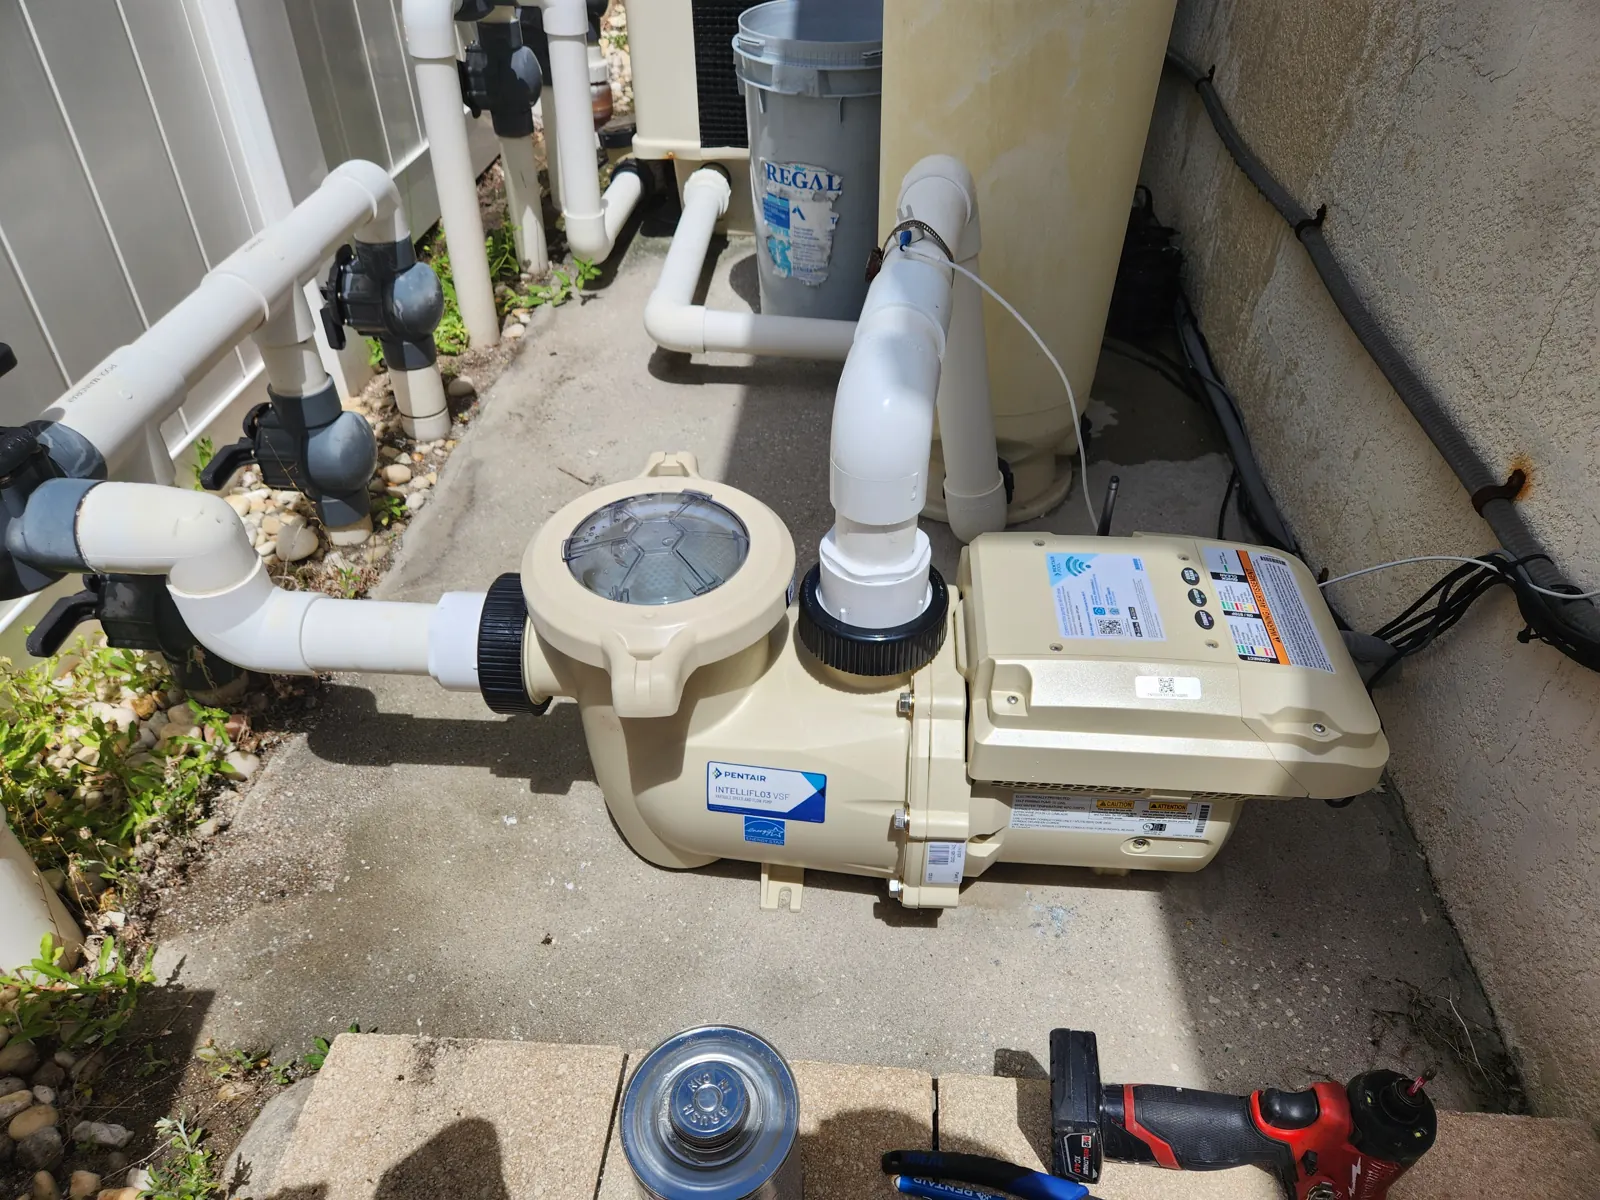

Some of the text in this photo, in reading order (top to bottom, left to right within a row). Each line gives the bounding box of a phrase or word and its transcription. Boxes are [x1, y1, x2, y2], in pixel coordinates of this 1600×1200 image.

[765, 162, 842, 192] REGAL
[724, 771, 766, 782] PENTAIR
[773, 792, 790, 801] VSF
